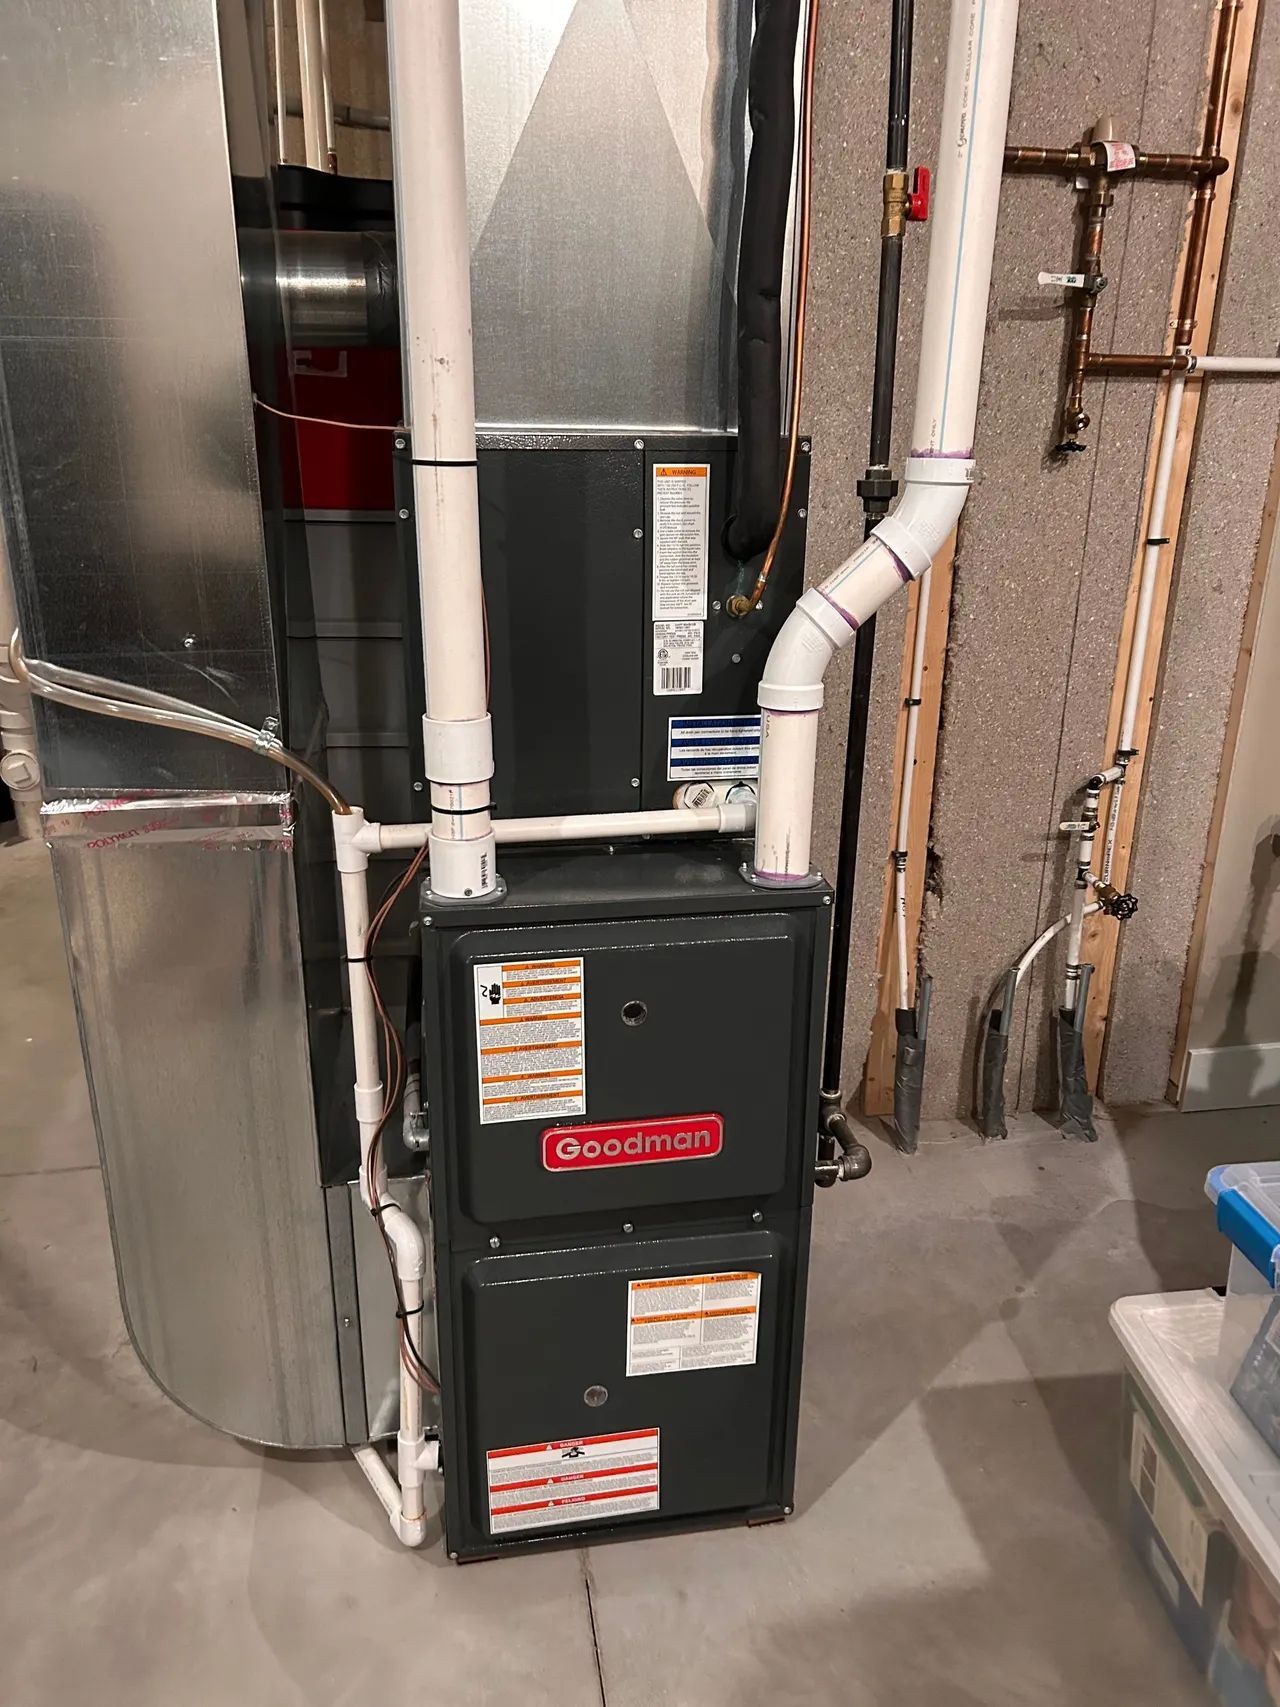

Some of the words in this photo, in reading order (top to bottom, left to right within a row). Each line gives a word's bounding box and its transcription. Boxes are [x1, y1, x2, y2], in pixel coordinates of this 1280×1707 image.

[965, 40, 973, 82] CELLULAR
[87, 829, 140, 849] POLYKEN
[555, 1129, 712, 1161] Goodman
[559, 1440, 584, 1448] DANGER
[560, 1474, 585, 1482] DANGER
[561, 1496, 586, 1504] PELIGRO
